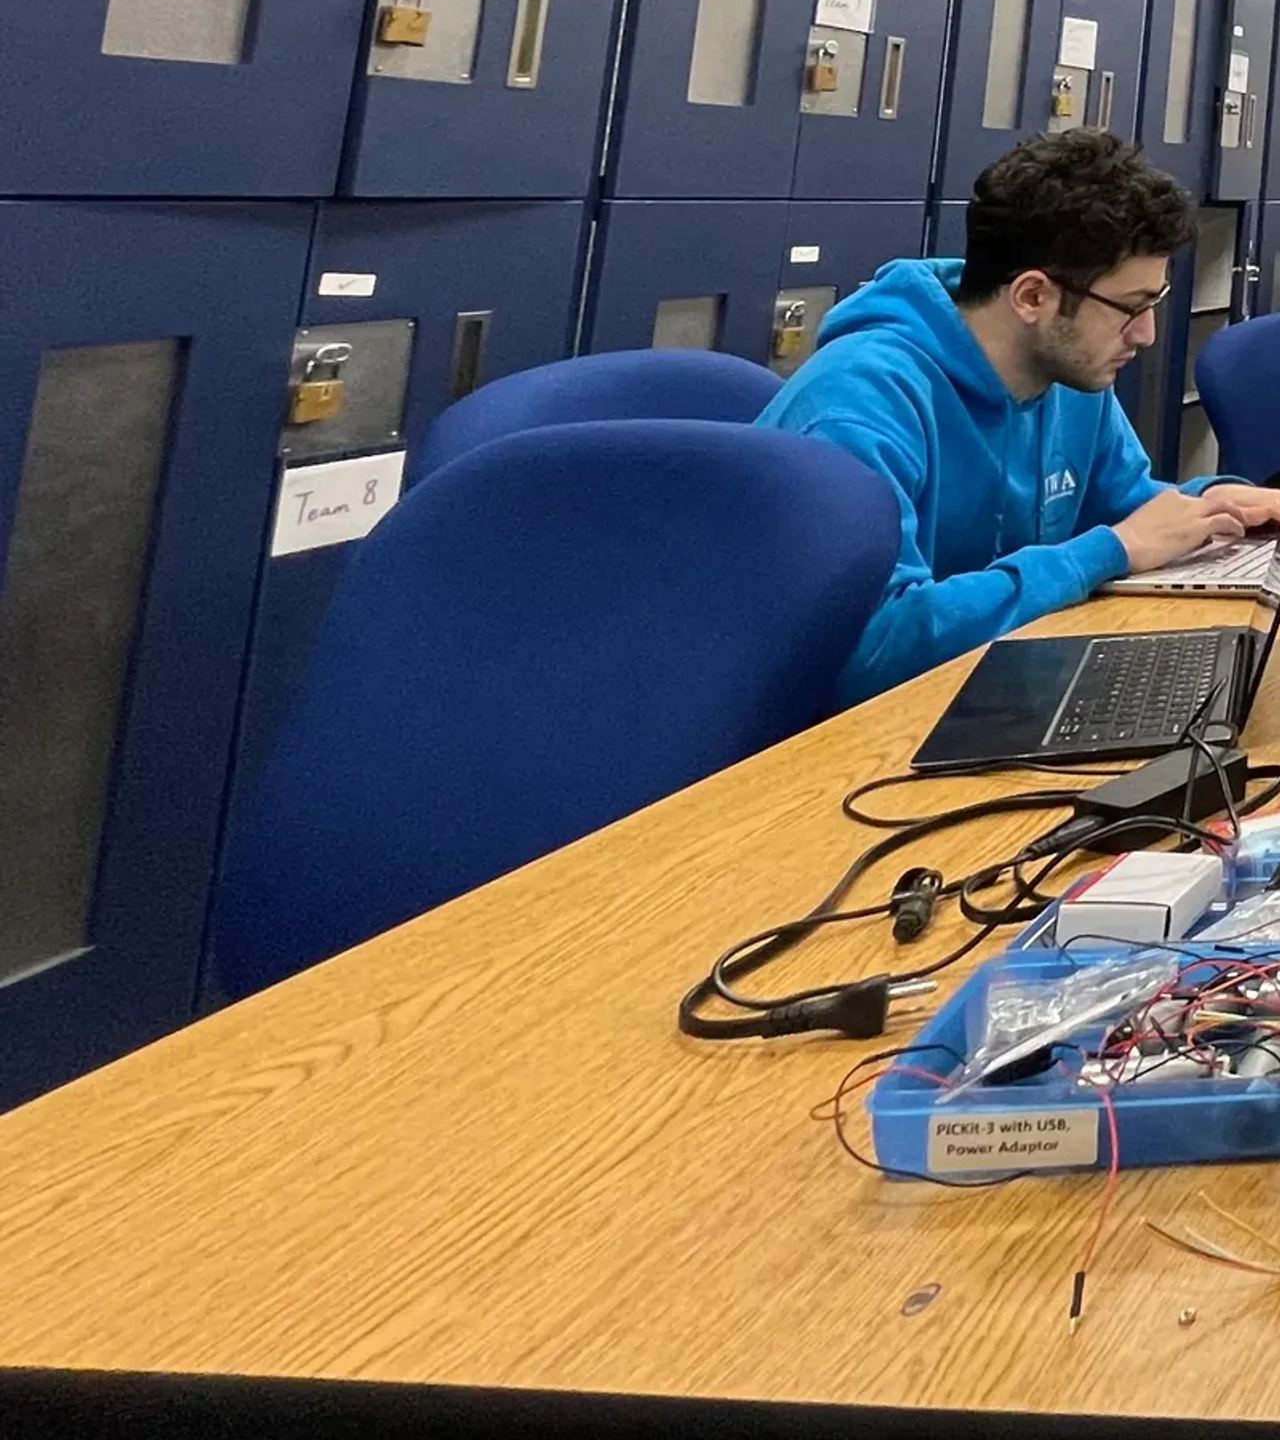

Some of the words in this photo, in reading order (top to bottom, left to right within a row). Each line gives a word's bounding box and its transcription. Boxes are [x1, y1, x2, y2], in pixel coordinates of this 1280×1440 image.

[294, 490, 351, 526] Team
[362, 478, 379, 506] 8
[936, 1120, 996, 1137] PICKit-3
[999, 1119, 1033, 1134] with
[1036, 1118, 1072, 1134] USB,
[946, 1143, 994, 1157] Power
[998, 1140, 1060, 1156] Adaptor
